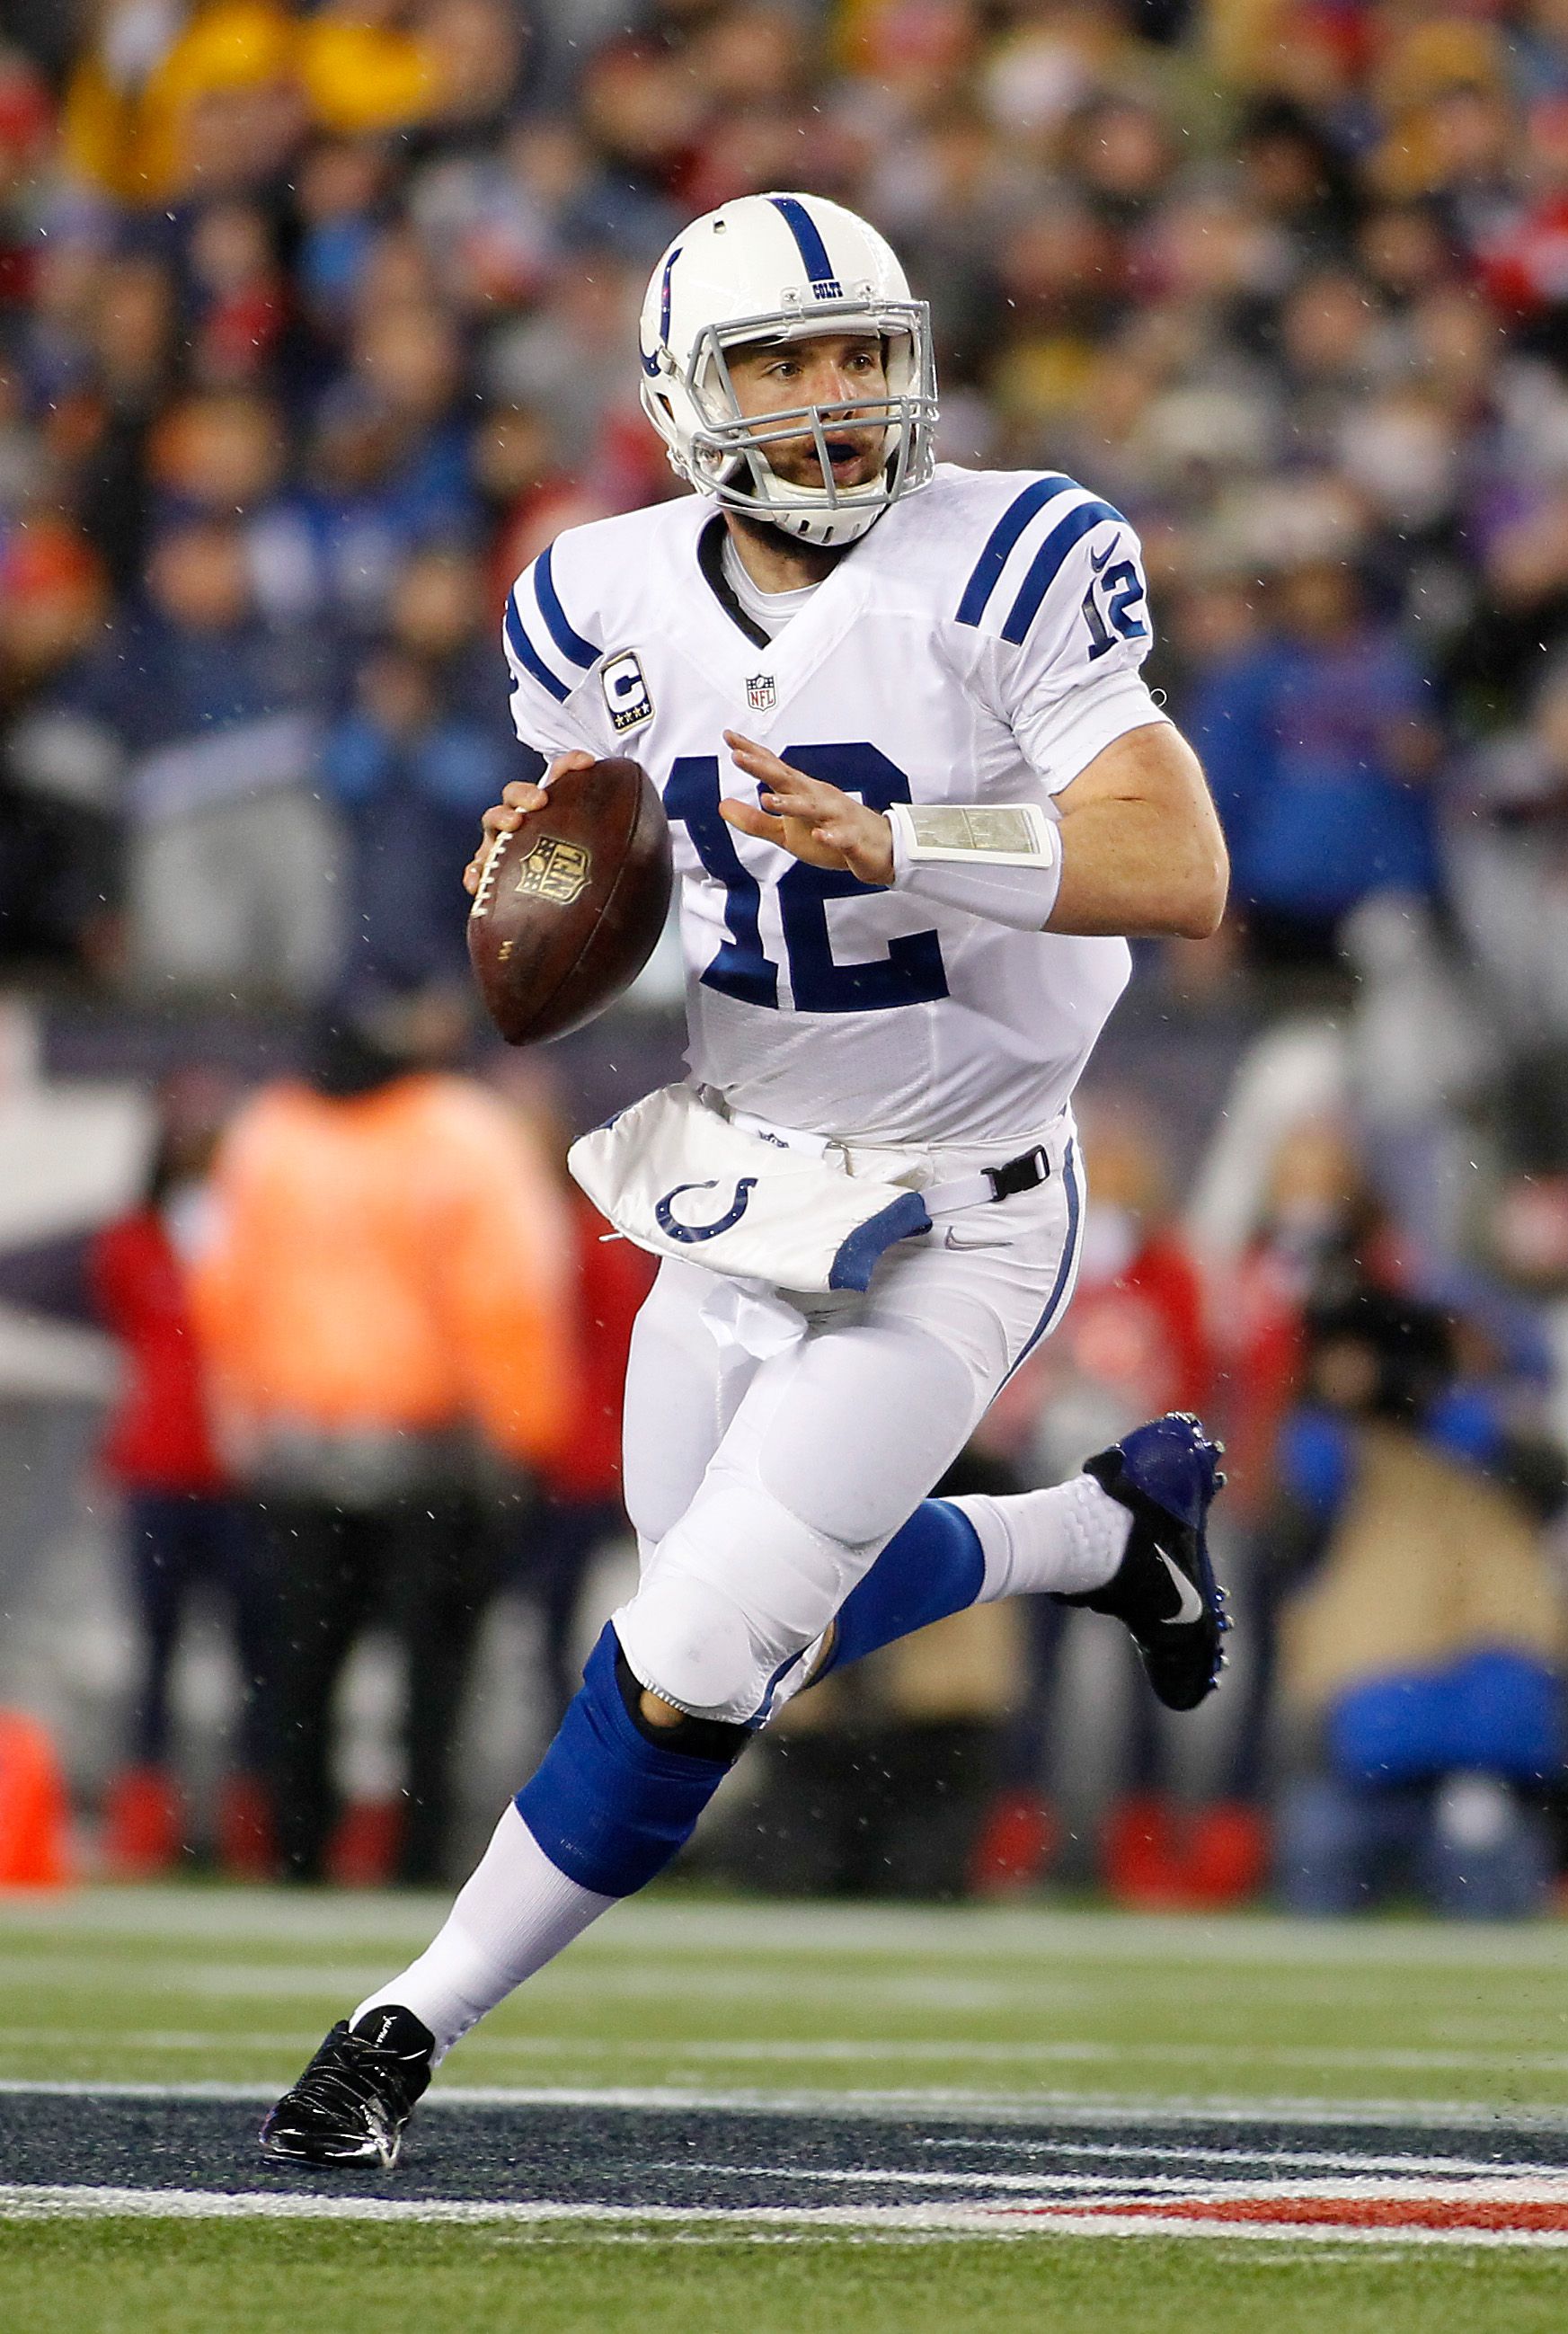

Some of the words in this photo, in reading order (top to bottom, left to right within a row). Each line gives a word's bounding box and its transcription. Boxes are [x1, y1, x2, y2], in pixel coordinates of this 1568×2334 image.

[812, 281, 844, 299] COLTS
[1081, 559, 1147, 661] 12
[603, 658, 646, 714] C
[749, 689, 774, 707] NFL
[542, 847, 584, 897] NFL
[662, 741, 951, 1013] 12
